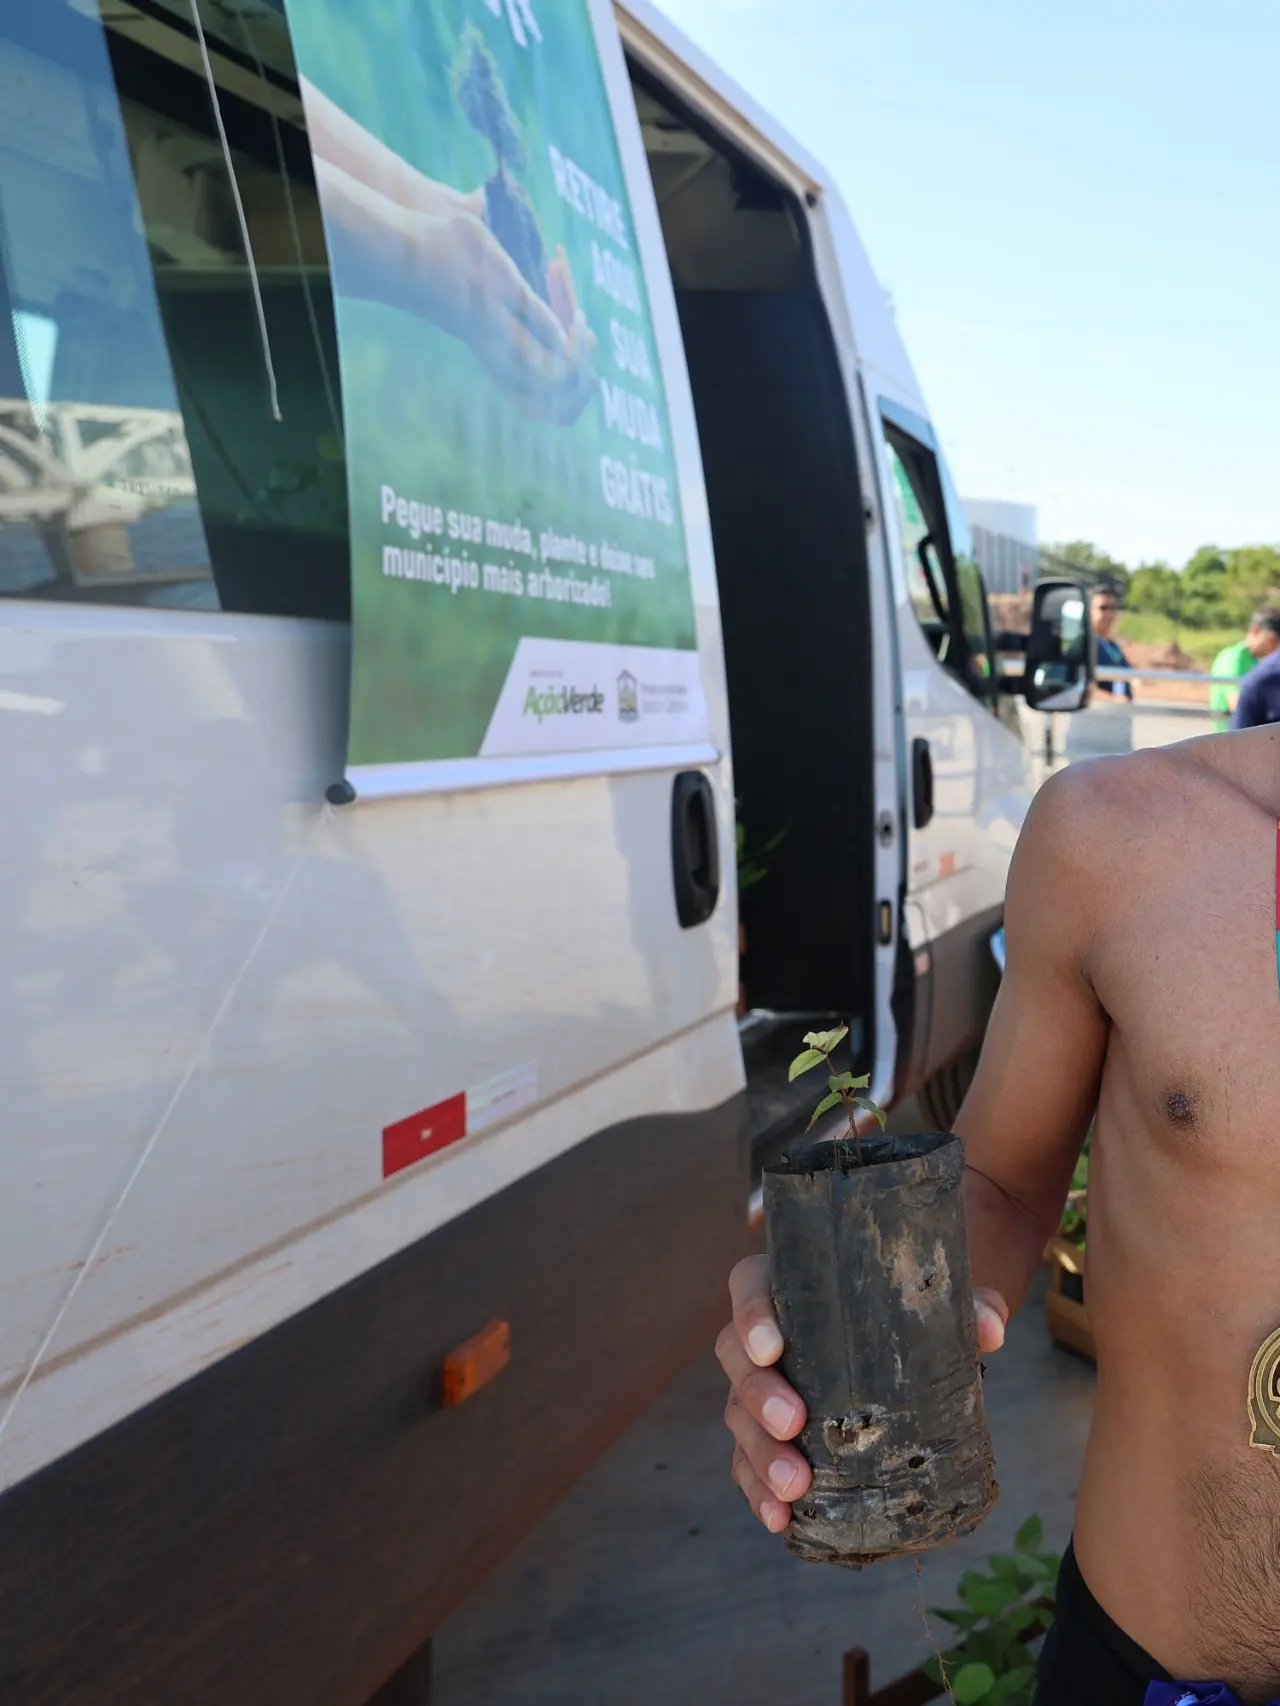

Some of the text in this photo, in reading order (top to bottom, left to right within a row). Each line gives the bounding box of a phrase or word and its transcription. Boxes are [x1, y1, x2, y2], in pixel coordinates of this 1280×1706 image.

[381, 485, 443, 539] Pegue
[447, 510, 482, 543] sua
[486, 519, 537, 560] muda,
[382, 543, 612, 608] município mais arborizado!
